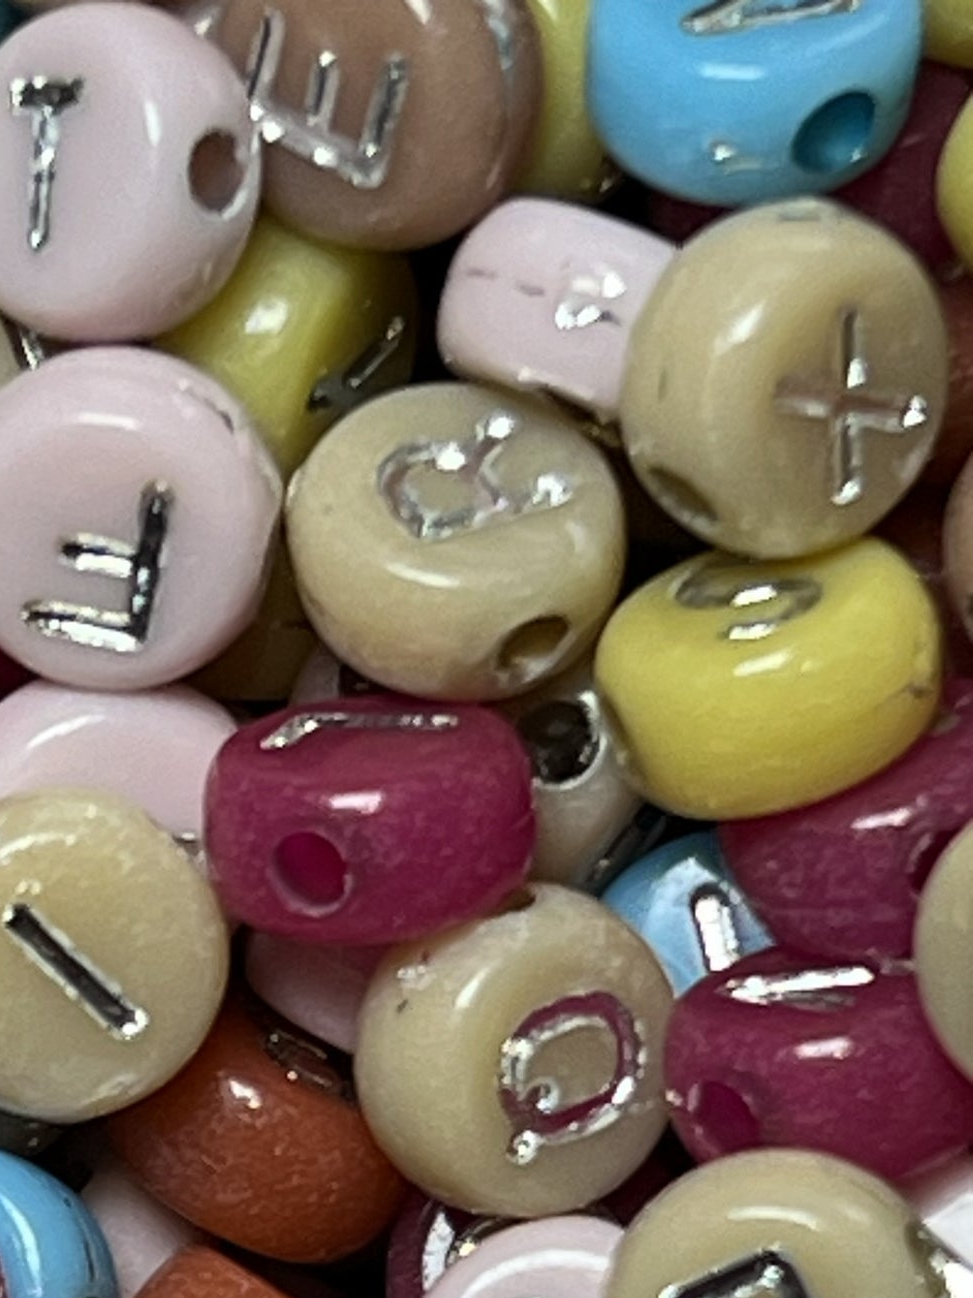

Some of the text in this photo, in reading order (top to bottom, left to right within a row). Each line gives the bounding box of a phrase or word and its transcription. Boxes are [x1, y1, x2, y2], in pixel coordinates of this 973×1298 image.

[10, 76, 85, 252] T
[25, 481, 175, 652] F
[2, 902, 149, 1040] I
[497, 990, 647, 1165] Q
